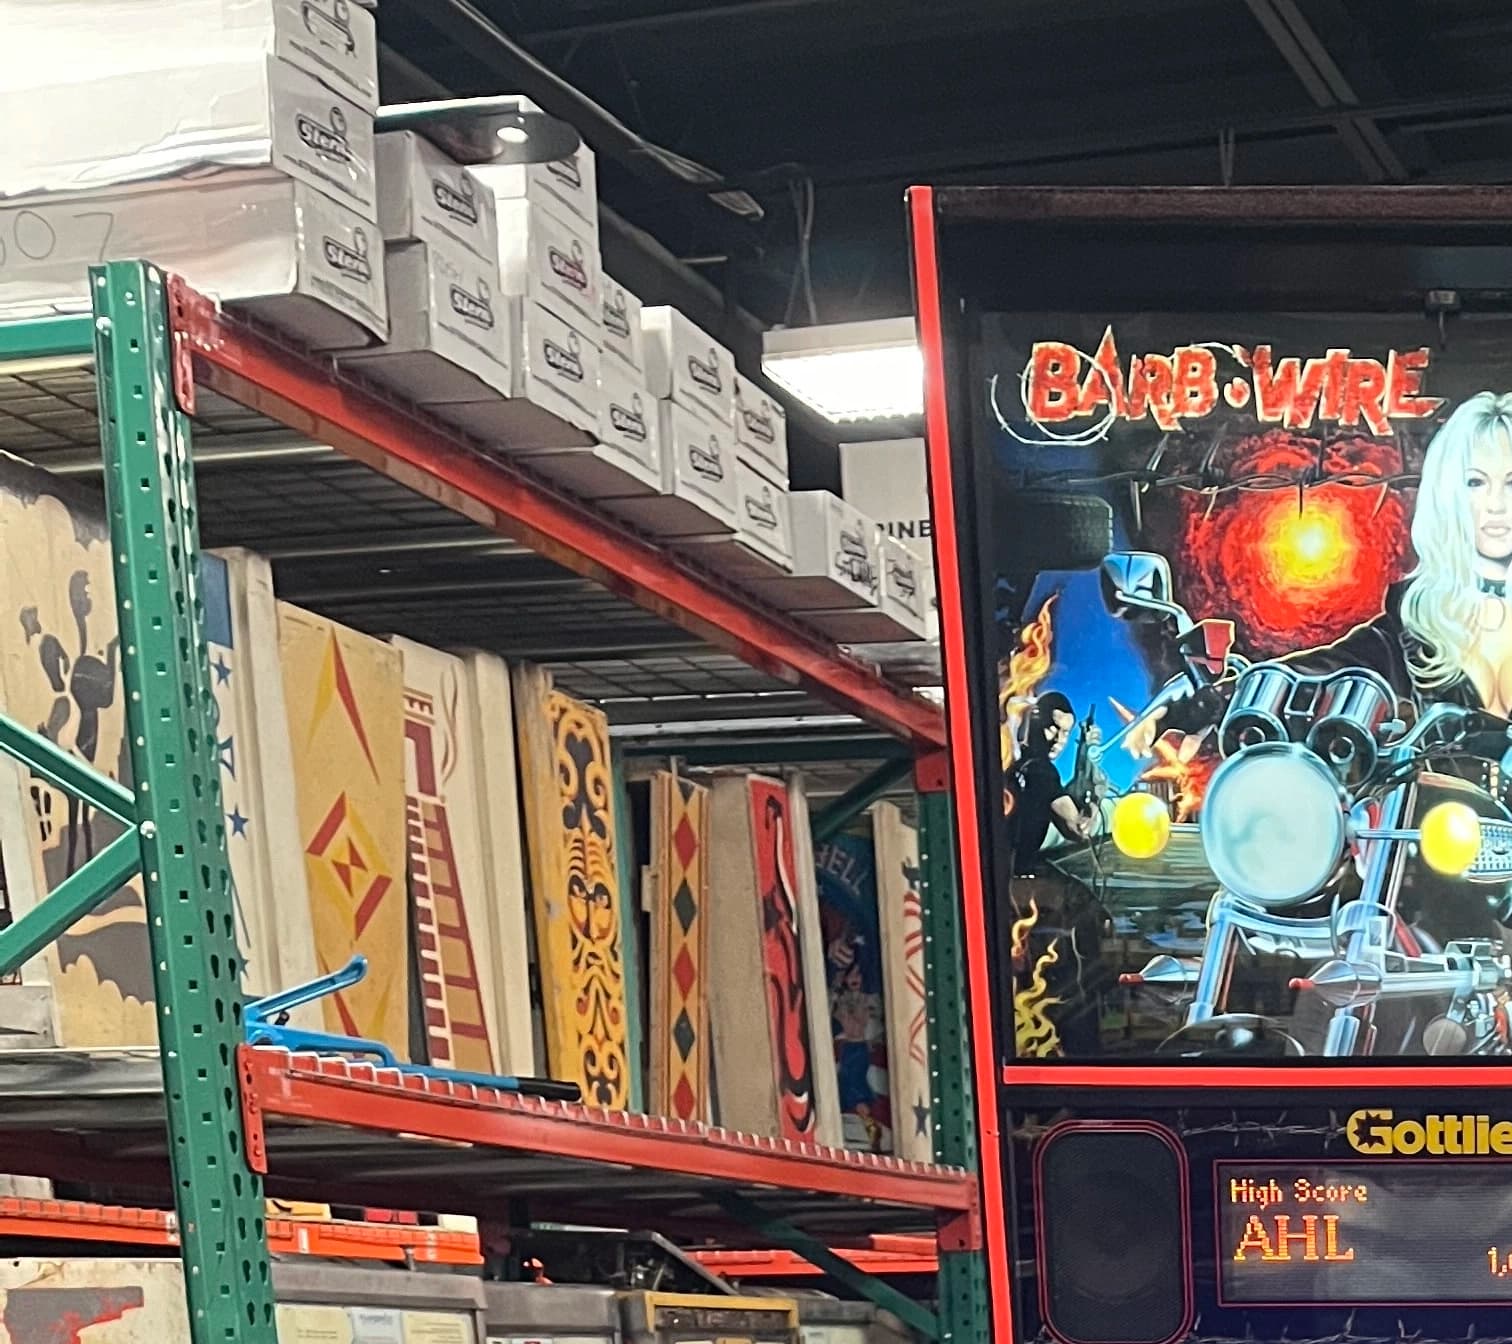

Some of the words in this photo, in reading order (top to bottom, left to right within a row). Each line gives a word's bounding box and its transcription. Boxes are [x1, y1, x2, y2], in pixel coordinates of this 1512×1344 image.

[1030, 325, 1219, 431] BARB
[1235, 344, 1448, 436] WIRE
[1230, 1178, 1283, 1211] High
[1294, 1178, 1368, 1202] Score
[1233, 1214, 1355, 1262] AHL
